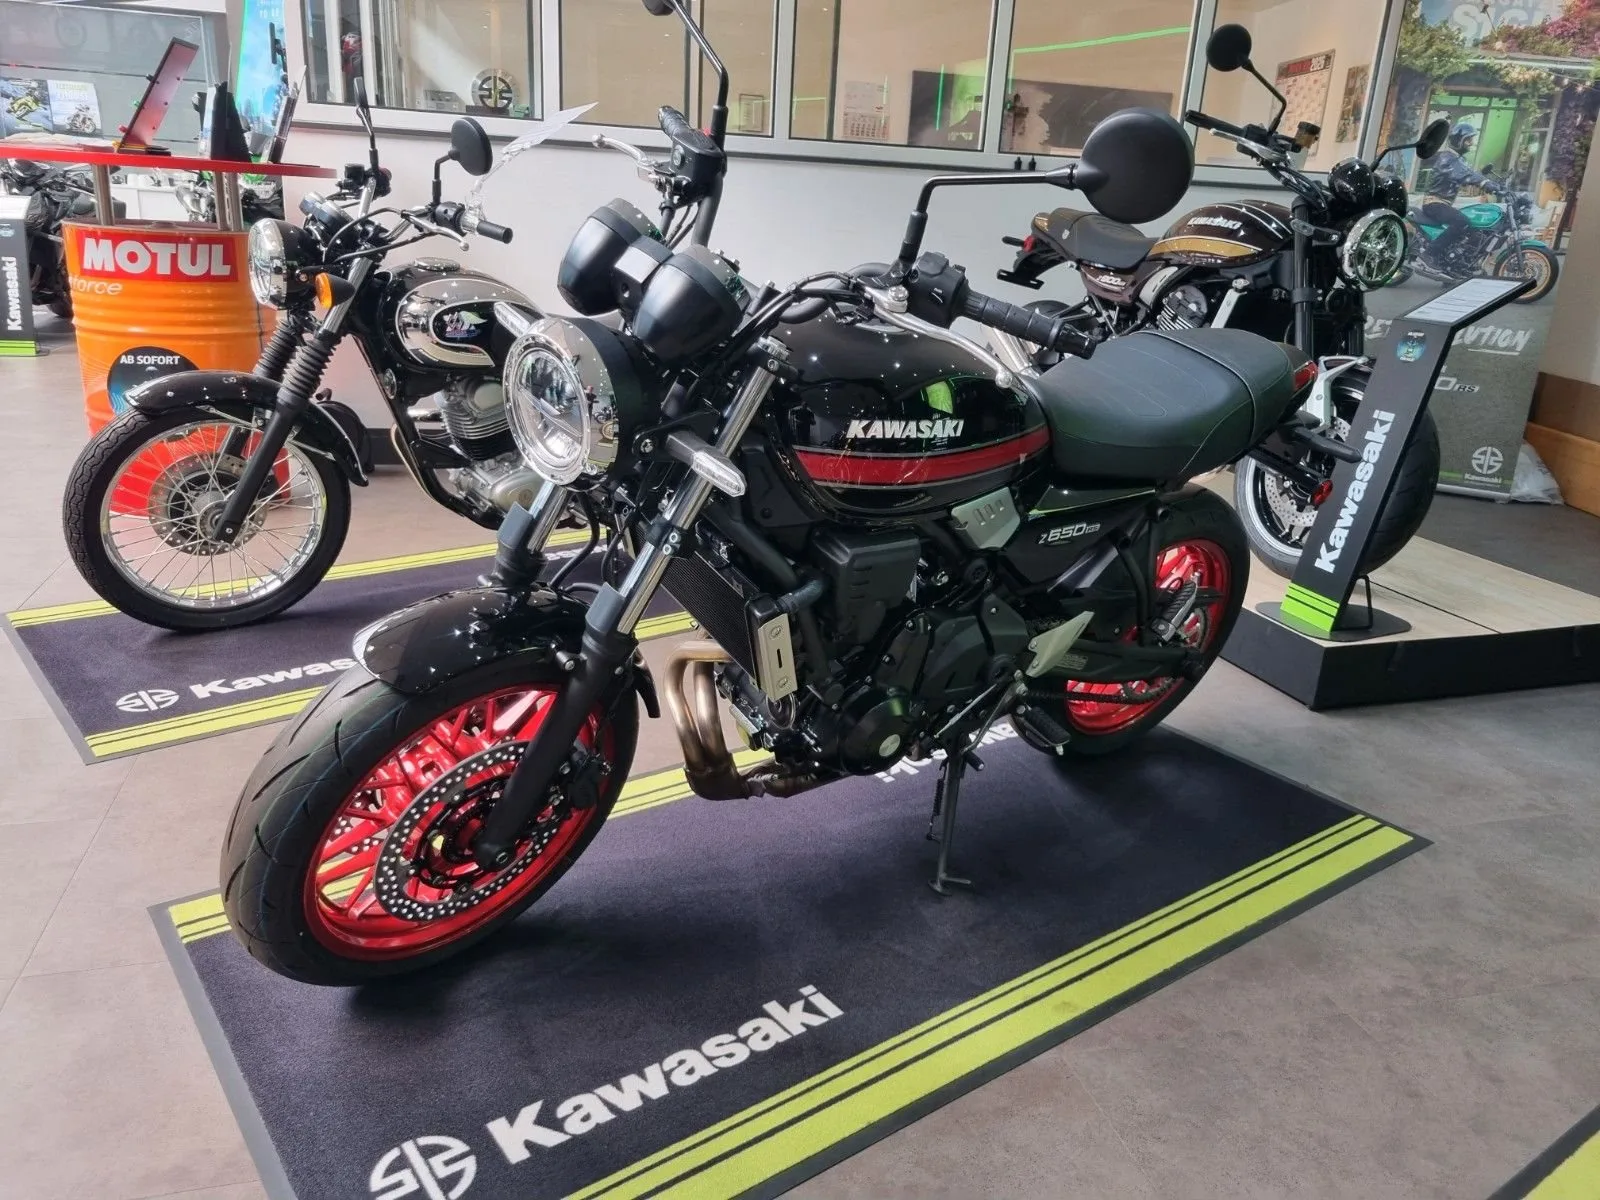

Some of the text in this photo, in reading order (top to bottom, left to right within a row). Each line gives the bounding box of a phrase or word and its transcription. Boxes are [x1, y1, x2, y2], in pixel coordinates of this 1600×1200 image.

[83, 237, 232, 277] MOTUL
[1, 256, 22, 331] Kawasaki
[119, 354, 181, 366] AB SOFORT
[845, 419, 965, 439] KAWASAKI
[1314, 409, 1396, 574] Kawasaki
[189, 657, 360, 699] Kawas
[486, 984, 844, 1165] Kawasaki
